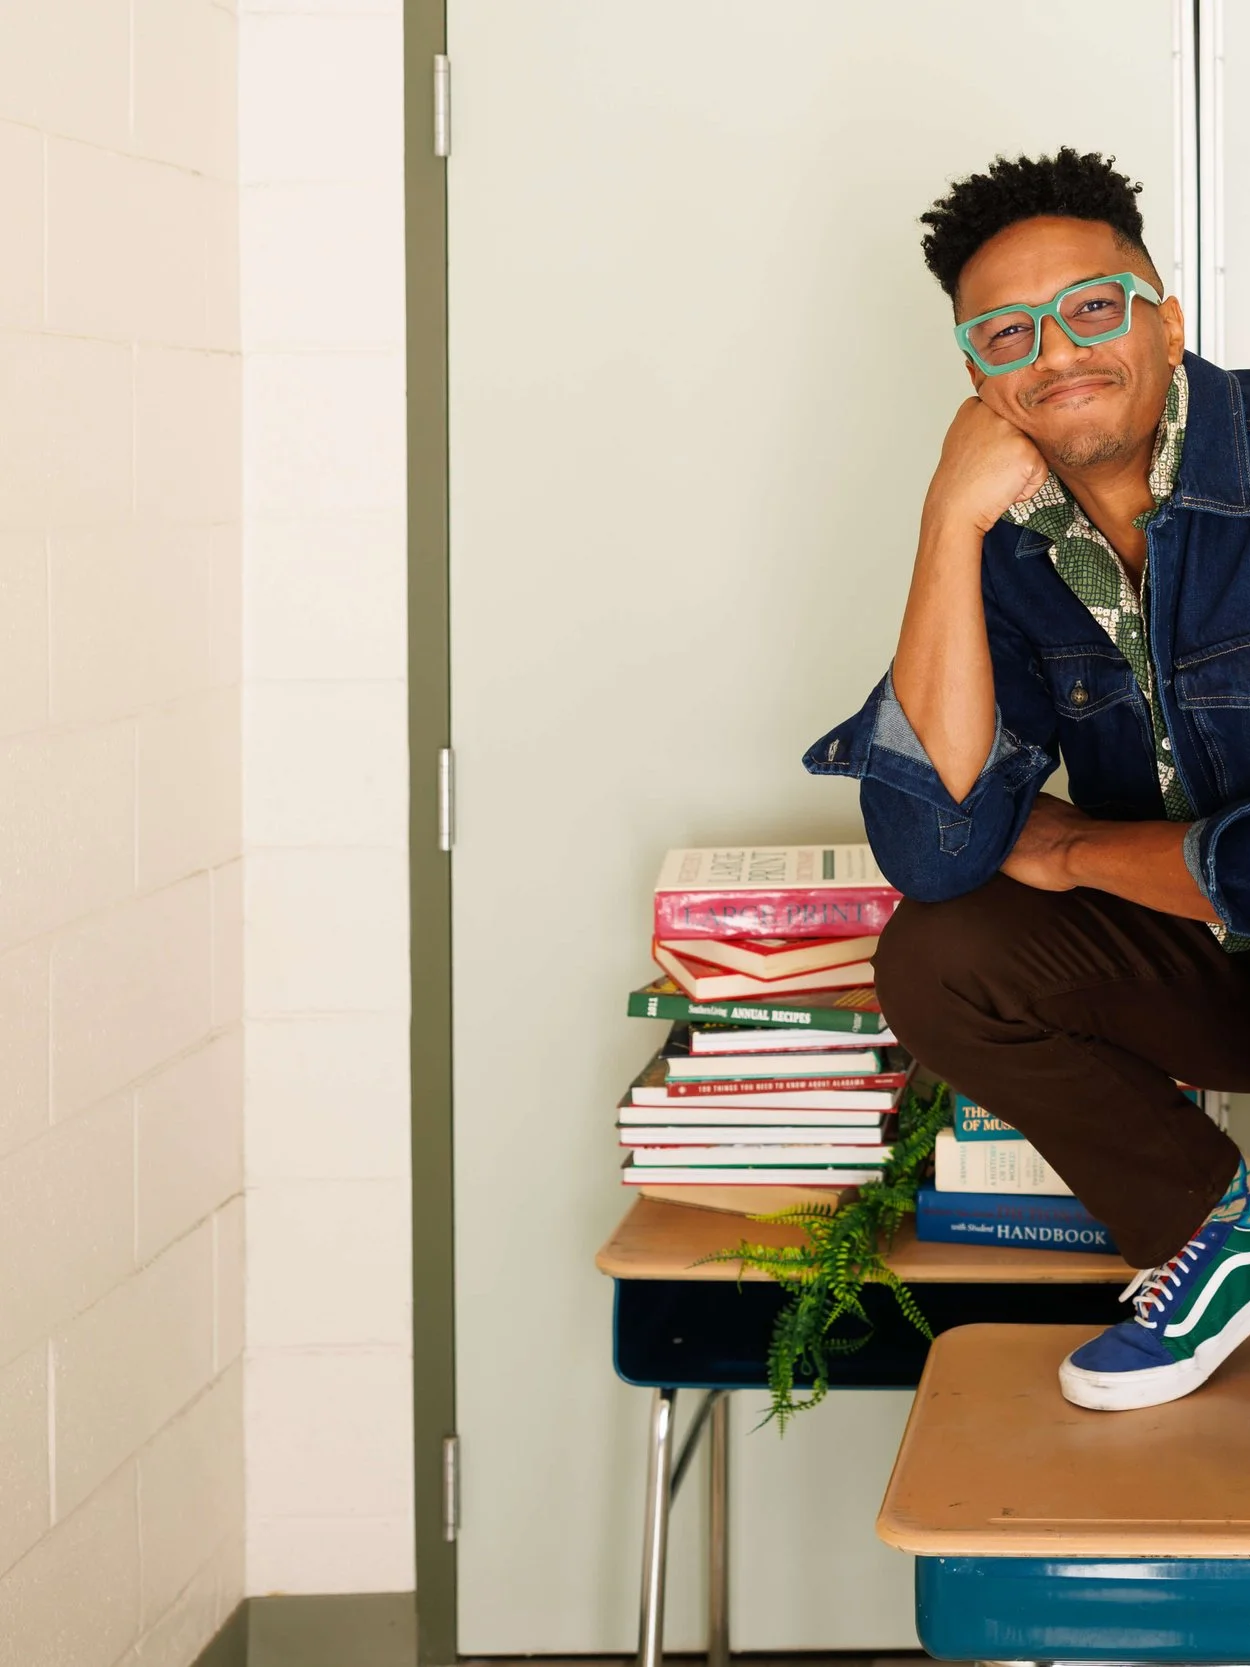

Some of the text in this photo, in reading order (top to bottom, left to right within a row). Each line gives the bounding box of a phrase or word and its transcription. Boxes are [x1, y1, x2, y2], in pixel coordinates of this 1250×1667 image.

[709, 851, 744, 882] LARGE
[748, 851, 787, 881] PRINT
[684, 902, 864, 927] LARGE PRINT
[646, 998, 659, 1017] 2011
[730, 1007, 770, 1021] ANNUAL
[771, 1010, 811, 1024] RECIPES
[808, 1080, 830, 1088] ABOUT
[832, 1079, 865, 1087] ALABAMA
[962, 1119, 981, 1131] OF
[967, 1224, 994, 1233] Student
[997, 1224, 1106, 1245] HANDBOOK
